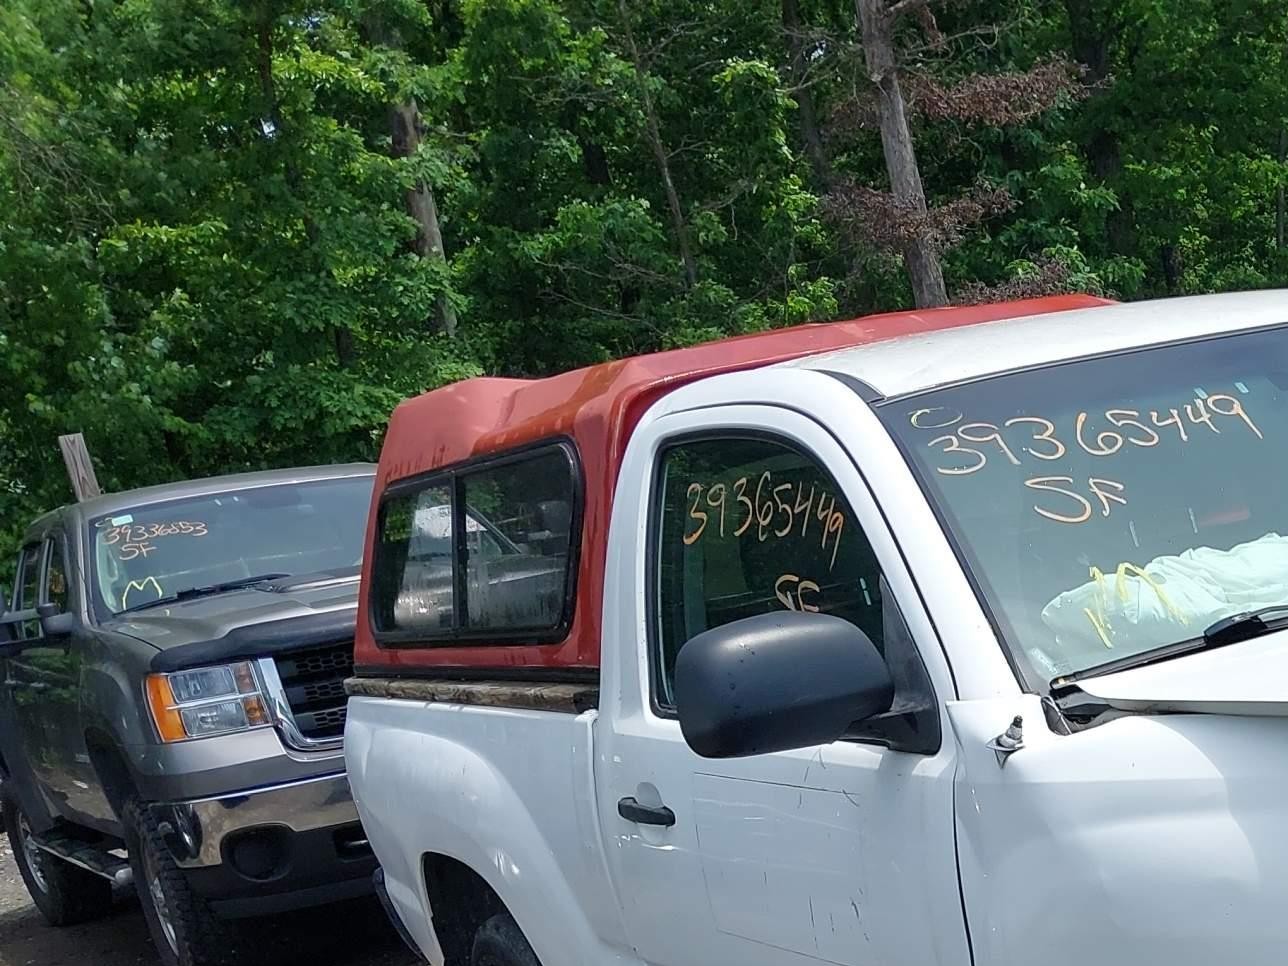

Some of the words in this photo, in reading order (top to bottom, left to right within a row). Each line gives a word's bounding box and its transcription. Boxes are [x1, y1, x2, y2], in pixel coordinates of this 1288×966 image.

[927, 394, 1264, 475] 39365449
[683, 471, 844, 571] 39365449
[1024, 476, 1128, 523] SF
[119, 542, 157, 560] SF
